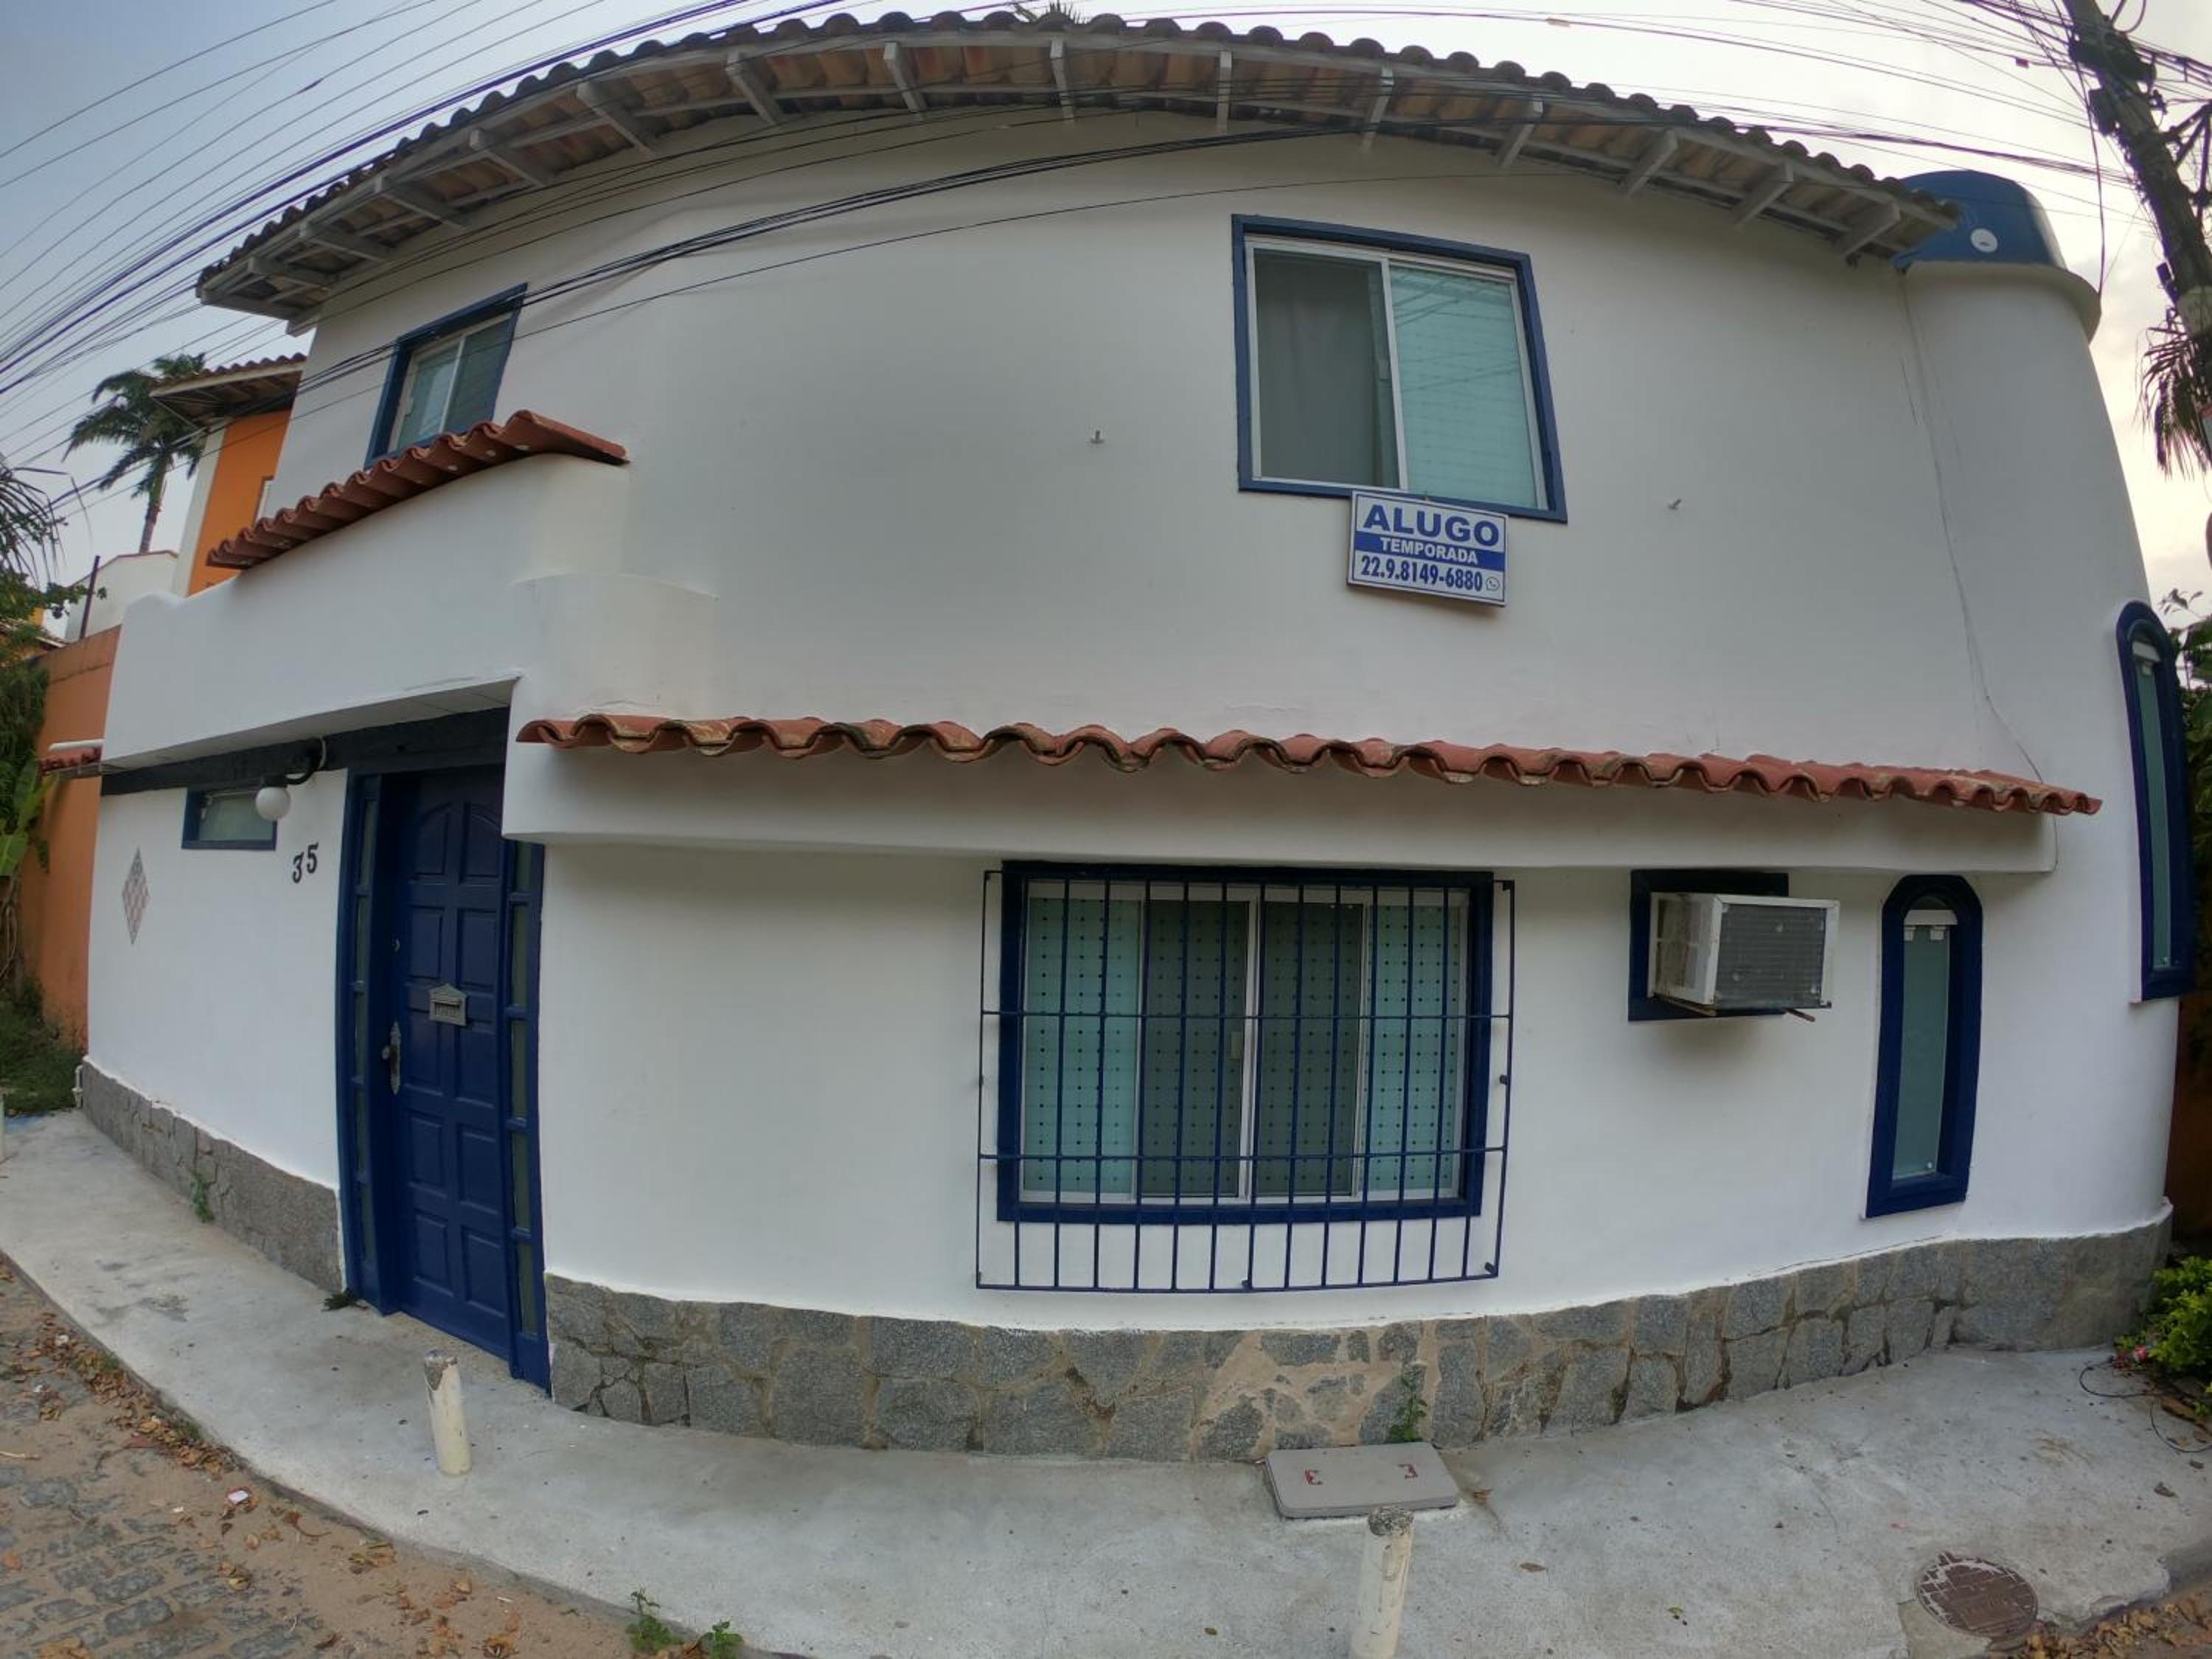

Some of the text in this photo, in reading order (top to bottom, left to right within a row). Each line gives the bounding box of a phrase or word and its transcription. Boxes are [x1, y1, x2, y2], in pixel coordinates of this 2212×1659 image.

[1364, 504, 1499, 546] ALUGO
[1380, 538, 1478, 564] TEMPORADA
[1361, 555, 1483, 591] 22.9.8149-6880
[292, 842, 319, 883] 35
